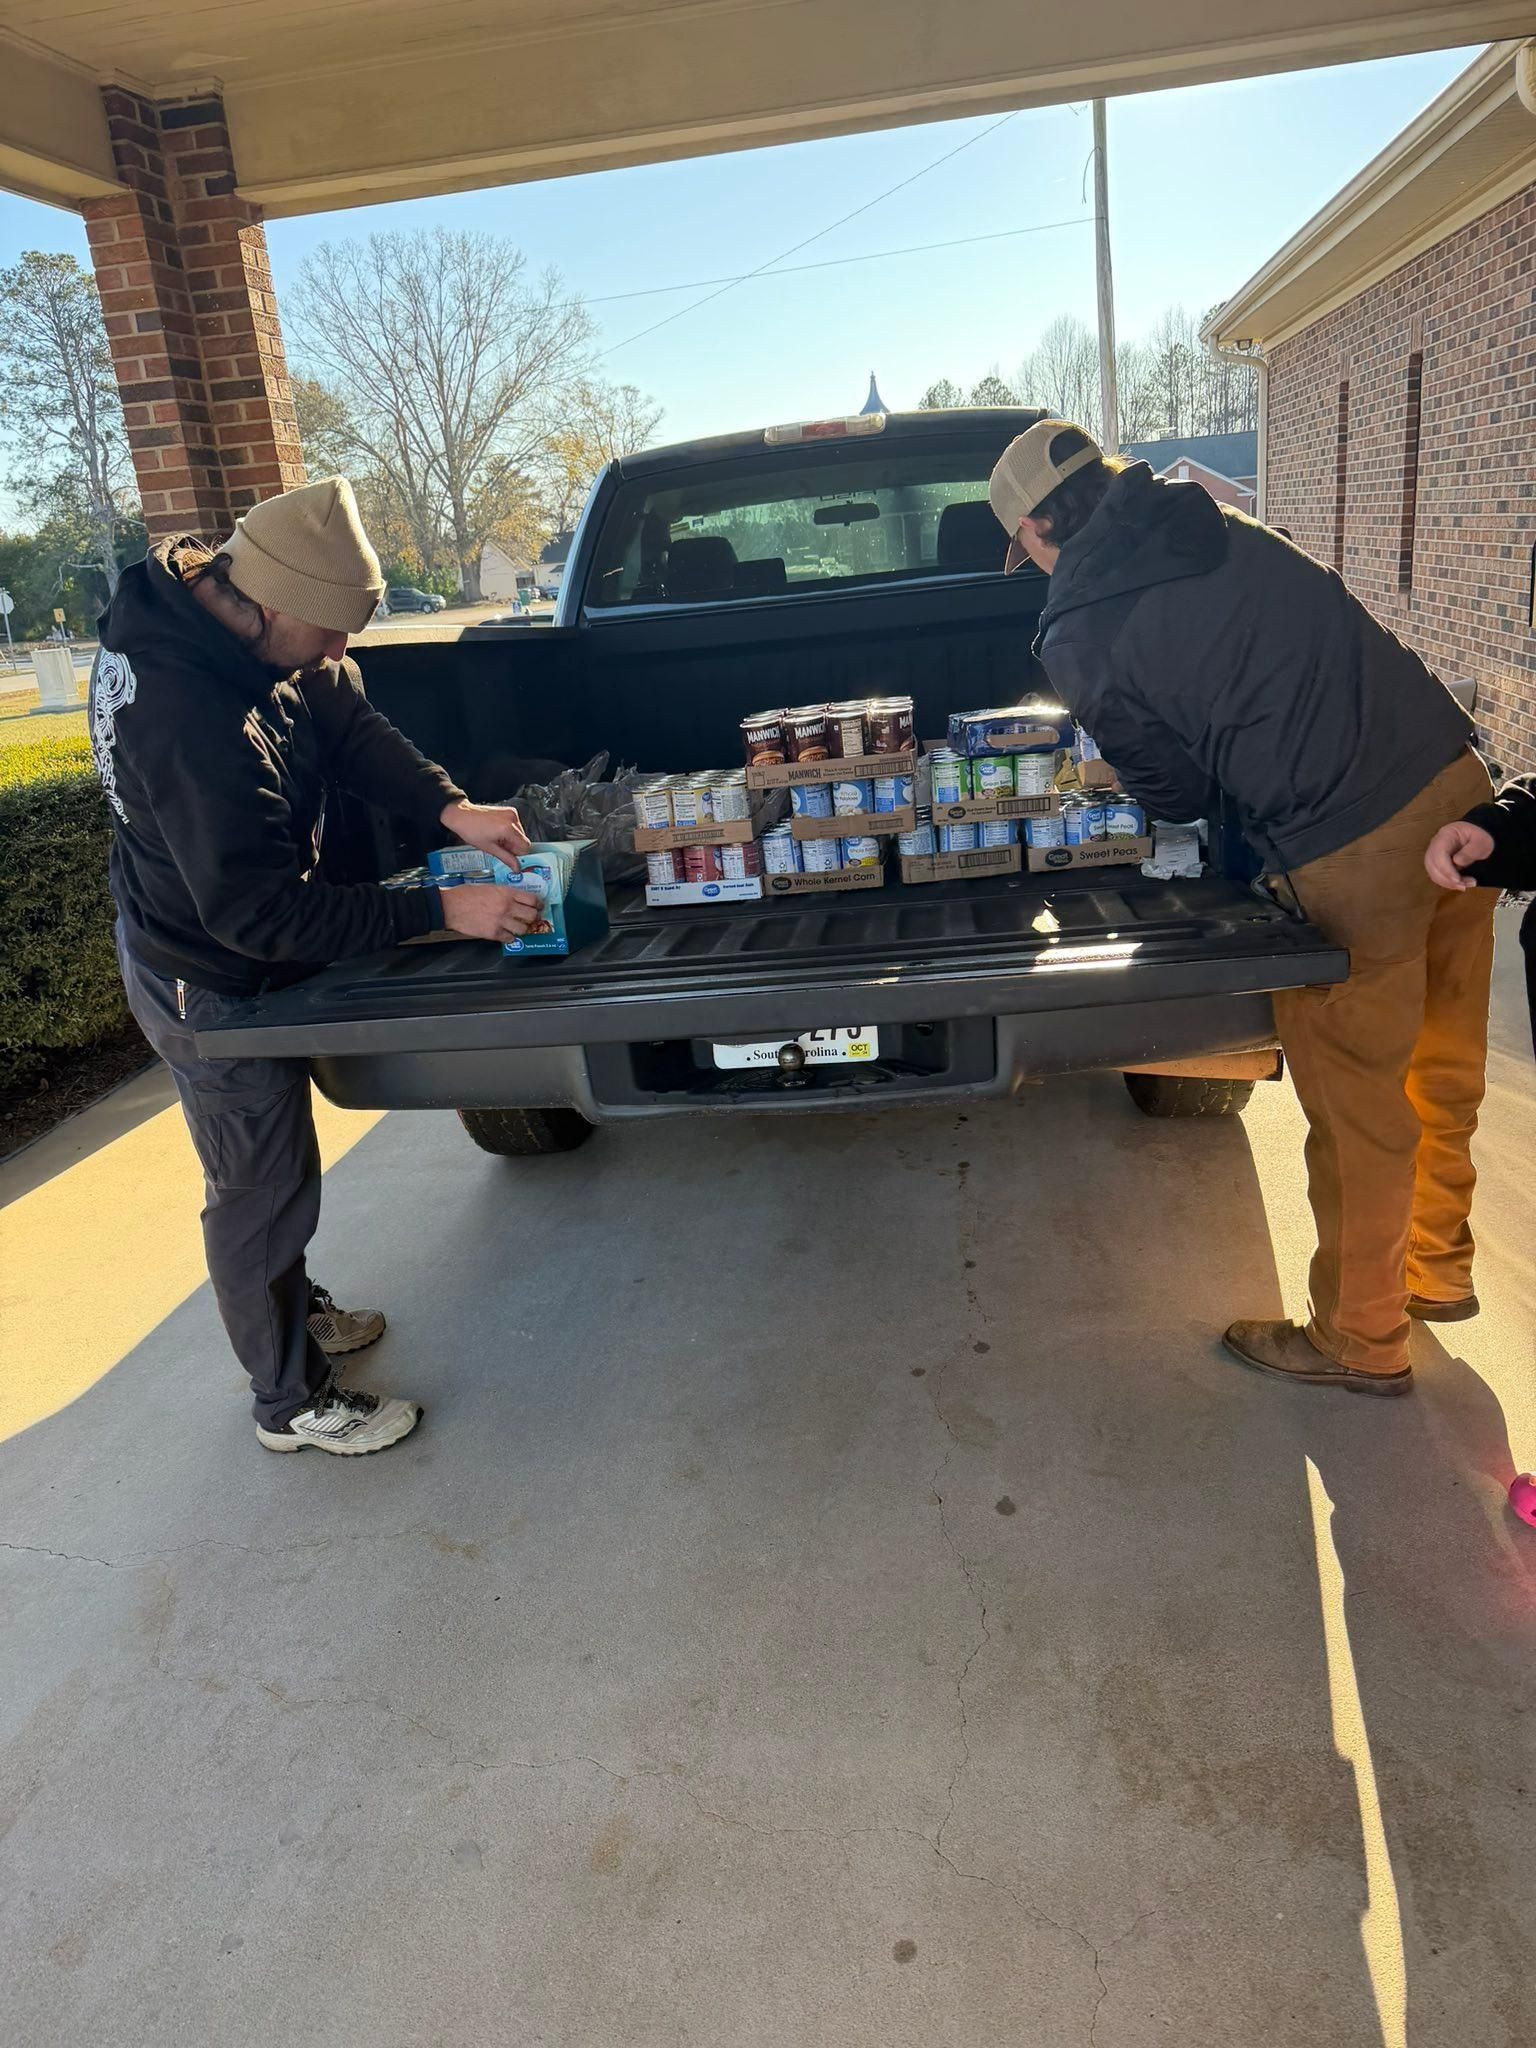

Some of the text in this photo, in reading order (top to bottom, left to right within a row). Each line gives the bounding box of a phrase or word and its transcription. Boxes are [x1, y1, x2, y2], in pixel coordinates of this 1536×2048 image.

[746, 725, 781, 744] MANWICH
[794, 722, 827, 740] MANWIC
[788, 767, 822, 781] MANWICH
[1079, 847, 1138, 860] Sweet Peas
[794, 872, 875, 886] Whole Kernel Corn
[753, 1046, 838, 1061] Sout rolina
[850, 1043, 868, 1052] OCT
